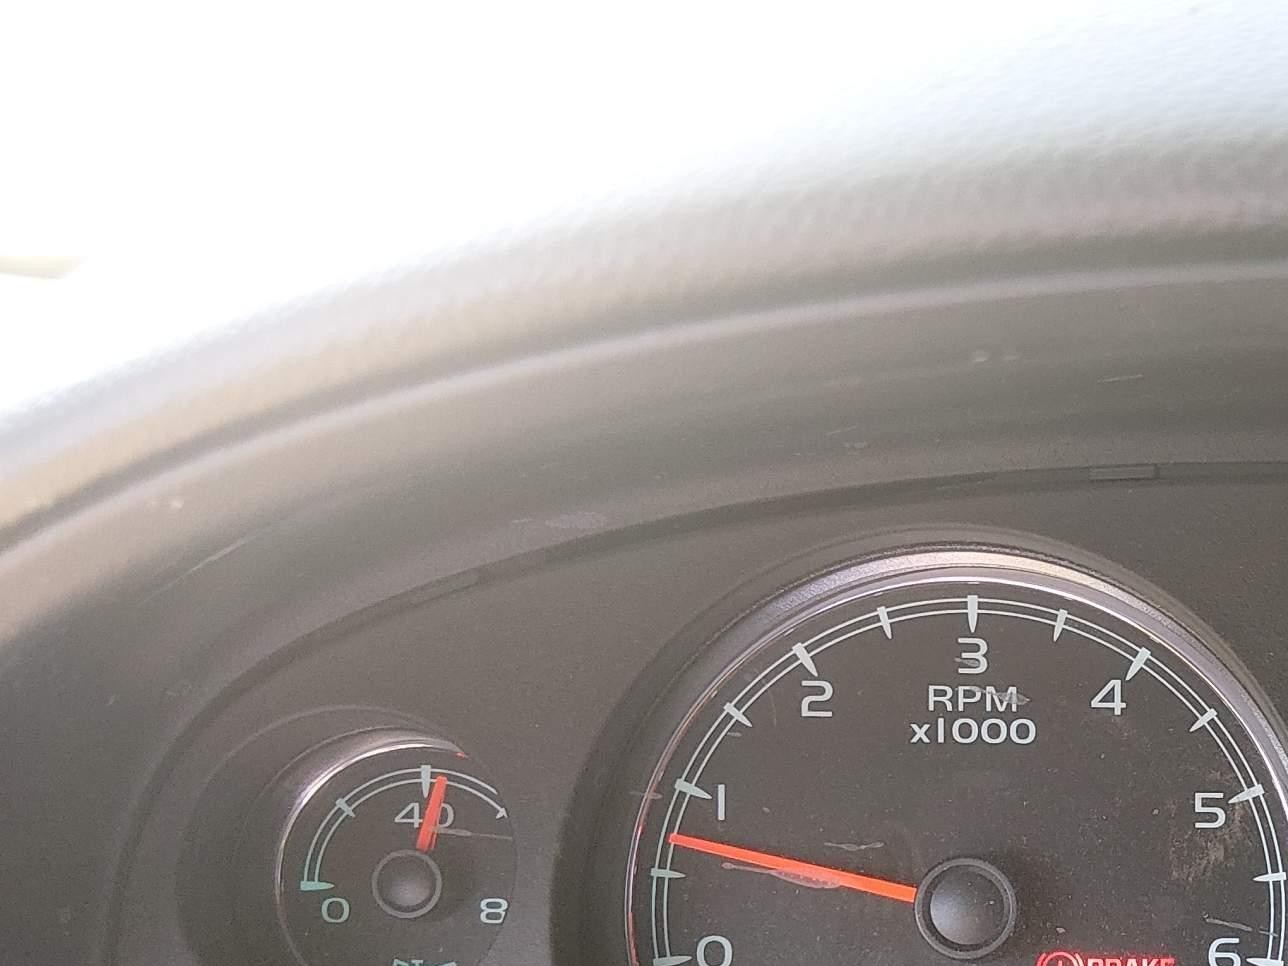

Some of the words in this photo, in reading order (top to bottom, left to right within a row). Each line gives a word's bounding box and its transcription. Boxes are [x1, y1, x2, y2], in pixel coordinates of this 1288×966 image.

[957, 637, 988, 674] 3
[801, 681, 834, 718] 2
[928, 685, 1018, 713] RPM
[1090, 680, 1127, 715] 4
[910, 718, 1036, 745] x1000
[717, 784, 725, 821] 1
[1194, 793, 1226, 828] 5
[321, 897, 349, 923] 0
